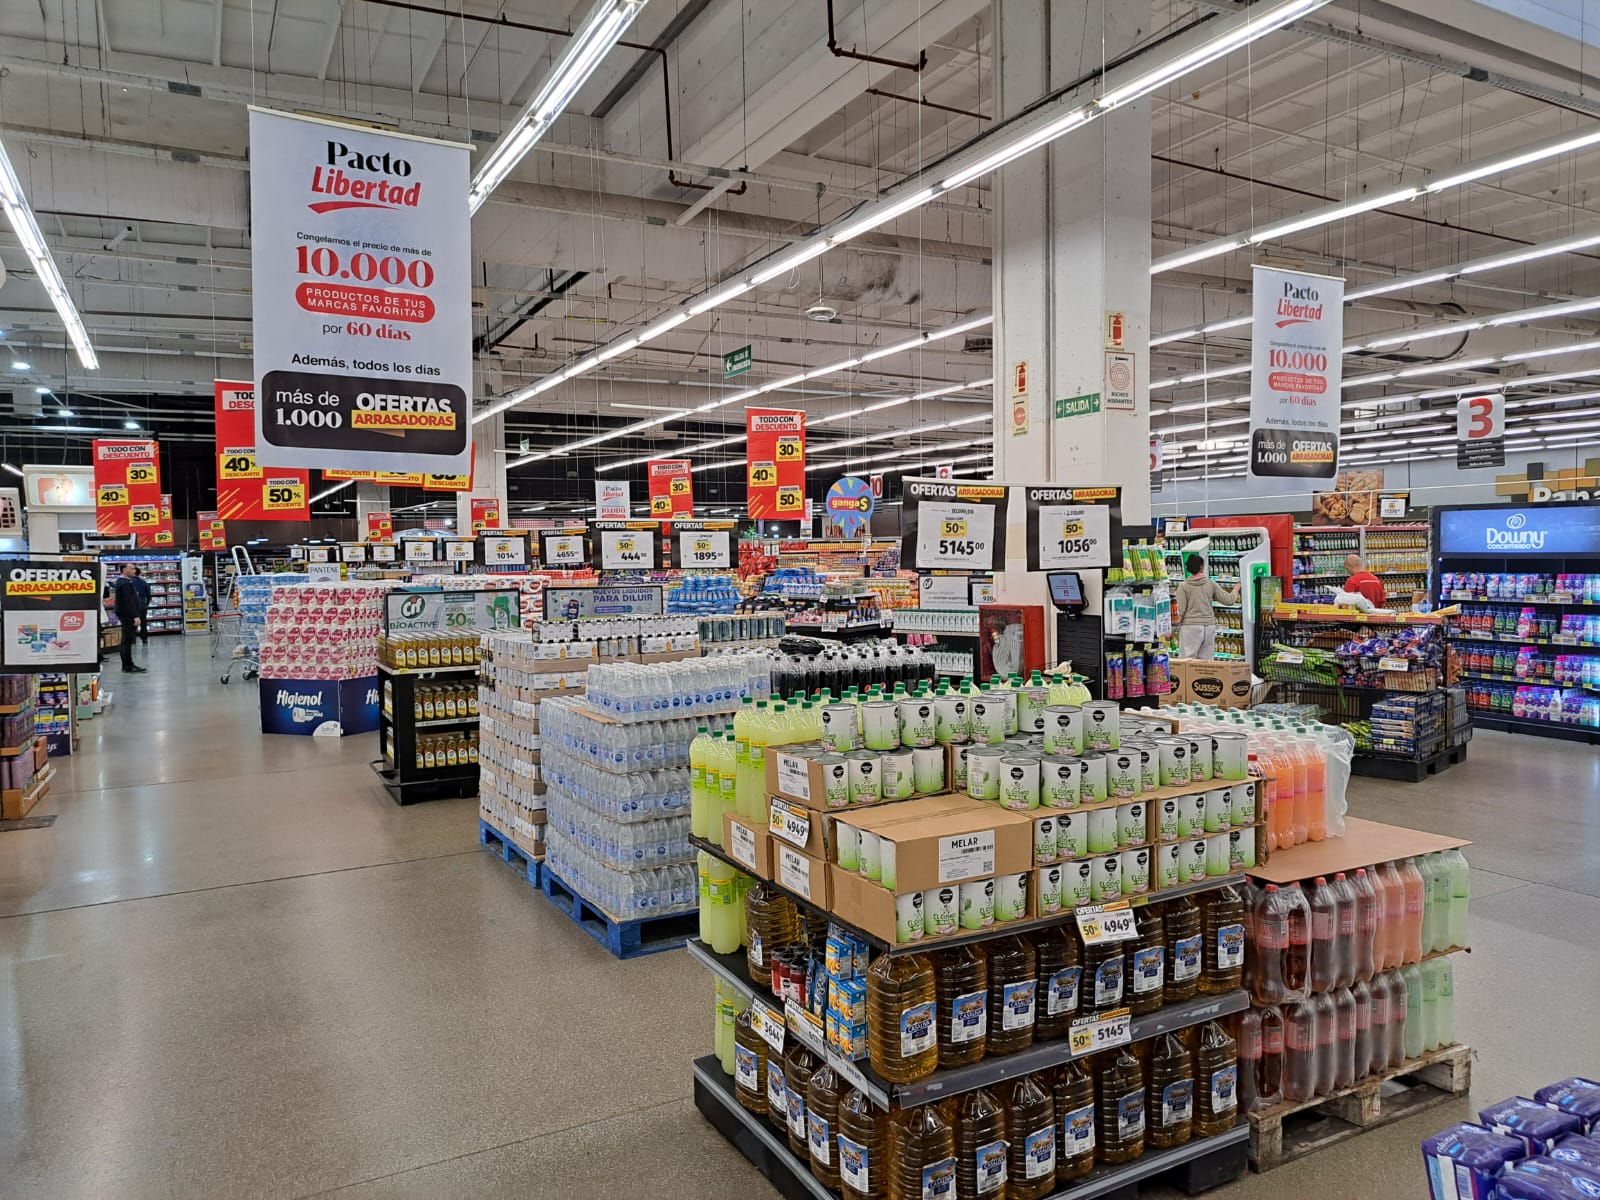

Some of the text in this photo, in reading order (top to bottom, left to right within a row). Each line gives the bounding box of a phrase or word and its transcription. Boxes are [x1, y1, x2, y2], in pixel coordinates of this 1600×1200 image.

[327, 141, 411, 177] Pacto
[312, 166, 422, 207] Libertad
[297, 232, 350, 246] Congelamos
[362, 241, 388, 253] precio
[390, 245, 400, 253] de
[403, 245, 419, 255] más
[422, 248, 432, 256] de
[296, 245, 434, 288] 10.000
[306, 288, 426, 308] PRODUCTOS DE TUS
[1284, 282, 1318, 301] Pacto
[308, 298, 425, 318] MARCAS FAVORITAS
[1277, 298, 1323, 320] Libertad
[323, 321, 411, 341] por 60 días
[292, 353, 440, 376] Además, todos los días
[1269, 349, 1327, 371] 10.000
[276, 389, 340, 406] más de
[356, 393, 452, 414] OFERTAS
[1066, 400, 1089, 413] SALIDA
[276, 409, 342, 428] 1.000
[354, 413, 453, 427] ARRASADORAS
[1468, 397, 1494, 438] 3
[1258, 440, 1286, 450] más de
[1293, 440, 1332, 452] OFERTAS
[1257, 451, 1287, 463] 1.000
[871, 478, 882, 497] 10
[910, 484, 1004, 497] OFERTAS ARRASADORAS
[1031, 489, 1116, 500] OFERTAS ARRASADORAS
[1487, 528, 1544, 549] Downy
[10, 568, 92, 583] OFERTAS
[8, 583, 94, 593] ARRASADORAS
[593, 594, 653, 603] PARA DILUIR
[1194, 682, 1220, 692] Sussex
[277, 689, 322, 709] Higienol
[783, 759, 799, 769] MELAR
[787, 819, 805, 837] 4949
[952, 837, 978, 849] MELAR
[786, 852, 800, 866] MELAR
[1105, 919, 1129, 932] 4949
[1072, 1014, 1099, 1026] OFERTAS
[1098, 1024, 1124, 1041] 5145
